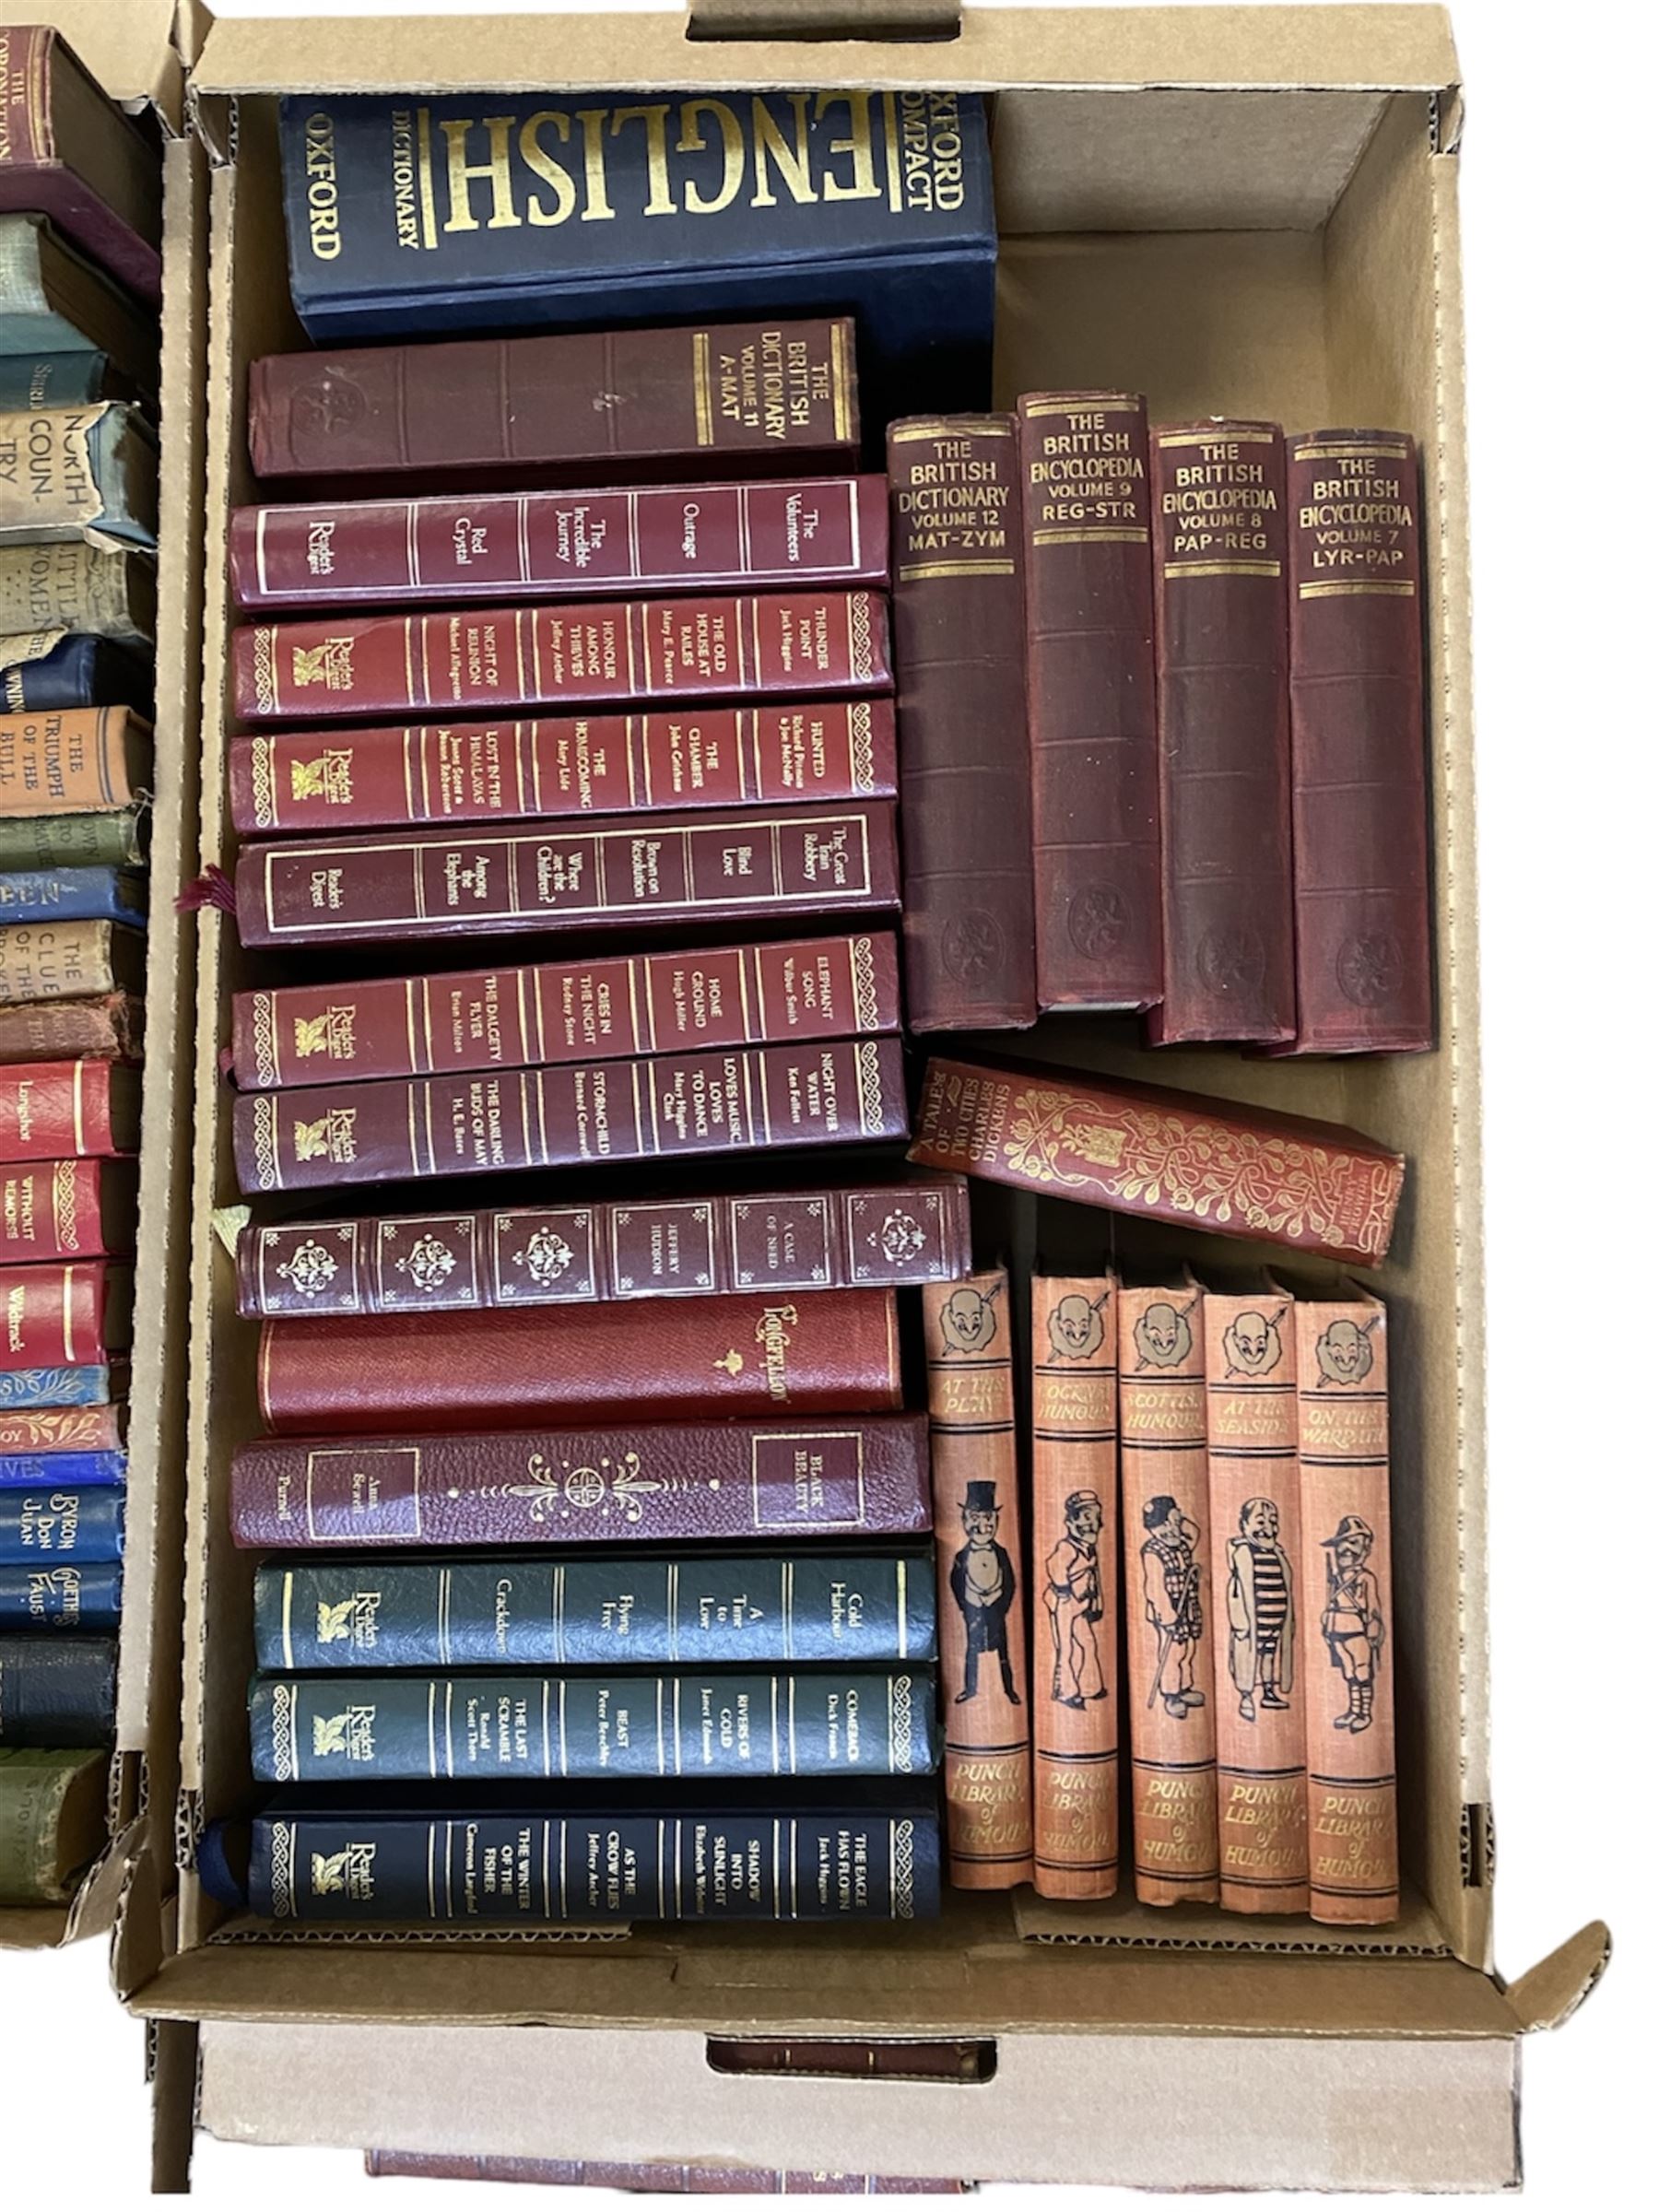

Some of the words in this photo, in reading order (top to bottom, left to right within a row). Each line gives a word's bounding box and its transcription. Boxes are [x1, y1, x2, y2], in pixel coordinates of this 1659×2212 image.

[439, 89, 883, 231] ENGLISH
[901, 92, 933, 212] OMPACT
[930, 92, 964, 211] XFORD
[306, 112, 341, 261] OXFORD
[392, 111, 419, 250] DICTIONARY
[719, 354, 741, 421] A-MAT
[761, 331, 787, 441] DICTIONARY
[787, 341, 810, 427] BRITISH
[811, 362, 830, 400] THE
[1066, 413, 1105, 430] THE
[0, 439, 18, 484] TRY
[29, 418, 53, 503] COUN-
[934, 441, 973, 460] THE
[1043, 432, 1131, 455] BRITISH
[1199, 442, 1241, 463] THE
[910, 461, 998, 487] BRITISH
[1030, 457, 1146, 485] ENCYCLOPEDIA
[1175, 464, 1265, 488] BRITISH
[1336, 458, 1377, 477] THE
[899, 485, 1011, 514] DICTIONARY
[1162, 489, 1278, 515] ENCYCLOPEDIA
[1312, 478, 1401, 501] BRITISH
[682, 502, 700, 559] Outrage
[785, 493, 803, 562] Volunteers
[804, 509, 819, 539] The
[911, 511, 977, 530] VOLUME
[982, 509, 1001, 527] 12
[1042, 500, 1137, 522] REG-STR
[1179, 512, 1246, 532] VOLUME
[1250, 512, 1264, 530] 8
[1300, 505, 1414, 530] ENCYCLOPEDIA
[452, 517, 473, 565] Crystal
[470, 527, 489, 554] Red
[555, 509, 573, 563] Journey
[573, 506, 592, 569] Incredible
[590, 519, 606, 549] The
[908, 529, 1006, 553] MAT-ZYM
[1173, 533, 1268, 554] PAP-REG
[1315, 529, 1383, 547] VOLUME
[1388, 529, 1401, 546] 7
[1312, 548, 1406, 571] LYR-PAP
[601, 619, 617, 679] HONOUR
[712, 616, 725, 642] THE
[798, 618, 813, 660] POINT
[814, 606, 830, 671] THUNDER
[467, 628, 482, 686] REUNION
[570, 625, 585, 678] THIEVES
[585, 626, 601, 677] AMONG
[713, 642, 727, 673] OLD
[23, 724, 38, 746] OF
[68, 734, 84, 774] THE
[705, 740, 719, 771] THE
[810, 720, 826, 779] HUNTED
[0, 732, 17, 786] BULL
[23, 751, 39, 792] THE
[44, 714, 65, 798] TRIUMPH
[469, 735, 486, 806] HIMALAYAS
[575, 721, 593, 810] HOMECOMING
[593, 747, 606, 777] THE
[688, 726, 704, 789] CHAMBER
[803, 831, 818, 882] Robbery
[818, 841, 833, 871] Train
[832, 826, 847, 850] The
[443, 852, 463, 907] Elephants
[473, 854, 491, 900] Among
[535, 845, 557, 904] Children?
[568, 851, 583, 892] Where
[630, 839, 648, 899] Resolution
[722, 847, 737, 877] Love
[737, 845, 753, 876] Blind
[833, 851, 848, 886] Great
[310, 870, 327, 908] Digest
[15, 930, 30, 955] OF
[38, 932, 61, 994] CLUE
[64, 941, 84, 980] THE
[16, 964, 38, 999] THE
[484, 975, 499, 1003] THE
[580, 973, 594, 1002] THE
[691, 970, 708, 1029] GROUND
[708, 977, 724, 1018] HOME
[802, 970, 818, 1009] SONG
[817, 955, 834, 1020] ELEPHANT
[469, 1001, 484, 1040] FLYER
[486, 1004, 502, 1062] DALGETY
[582, 1003, 597, 1045] NIGHT
[488, 1078, 500, 1107] THE
[807, 1070, 821, 1116] WATER
[821, 1052, 837, 1095] NIGHT
[18, 1080, 35, 1142] Longshot
[593, 1070, 611, 1155] STORMCHILD
[708, 1080, 724, 1124] LOVES
[824, 1095, 840, 1132] OVER
[968, 1080, 995, 1162] CHARLES
[488, 1108, 506, 1166] DARLING
[935, 1126, 951, 1154] OF
[982, 1084, 1011, 1163] DICKENS
[5, 1179, 20, 1240] REMORSE
[20, 1175, 36, 1241] WITHOUT
[767, 1214, 779, 1232] OF
[651, 1223, 665, 1276] HUDSON
[768, 1235, 781, 1270] NEED
[7, 1285, 27, 1353] Wildtrack
[794, 1449, 809, 1513] BEAUTY
[809, 1454, 824, 1508] BLACK
[496, 1578, 512, 1655] Crackdown
[600, 1601, 616, 1630] Free
[617, 1594, 635, 1635] Flying
[699, 1595, 715, 1630] Love
[732, 1594, 747, 1629] Time
[830, 1581, 847, 1641] Harbour
[847, 1593, 864, 1629] Cold
[497, 1695, 513, 1763] SCRAMBLE
[513, 1698, 527, 1727] THE
[617, 1709, 629, 1748] BEAST
[720, 1707, 735, 1748] GOLD
[846, 1688, 859, 1762] COMEBACK
[515, 1728, 528, 1759] LAST
[854, 1833, 868, 1863] THE
[484, 1847, 499, 1894] FISHER
[712, 1834, 729, 1905] SUNLIGHT
[730, 1852, 744, 1889] INTO
[747, 1839, 761, 1901] SHADOW
[854, 1864, 868, 1908] EAGLE
